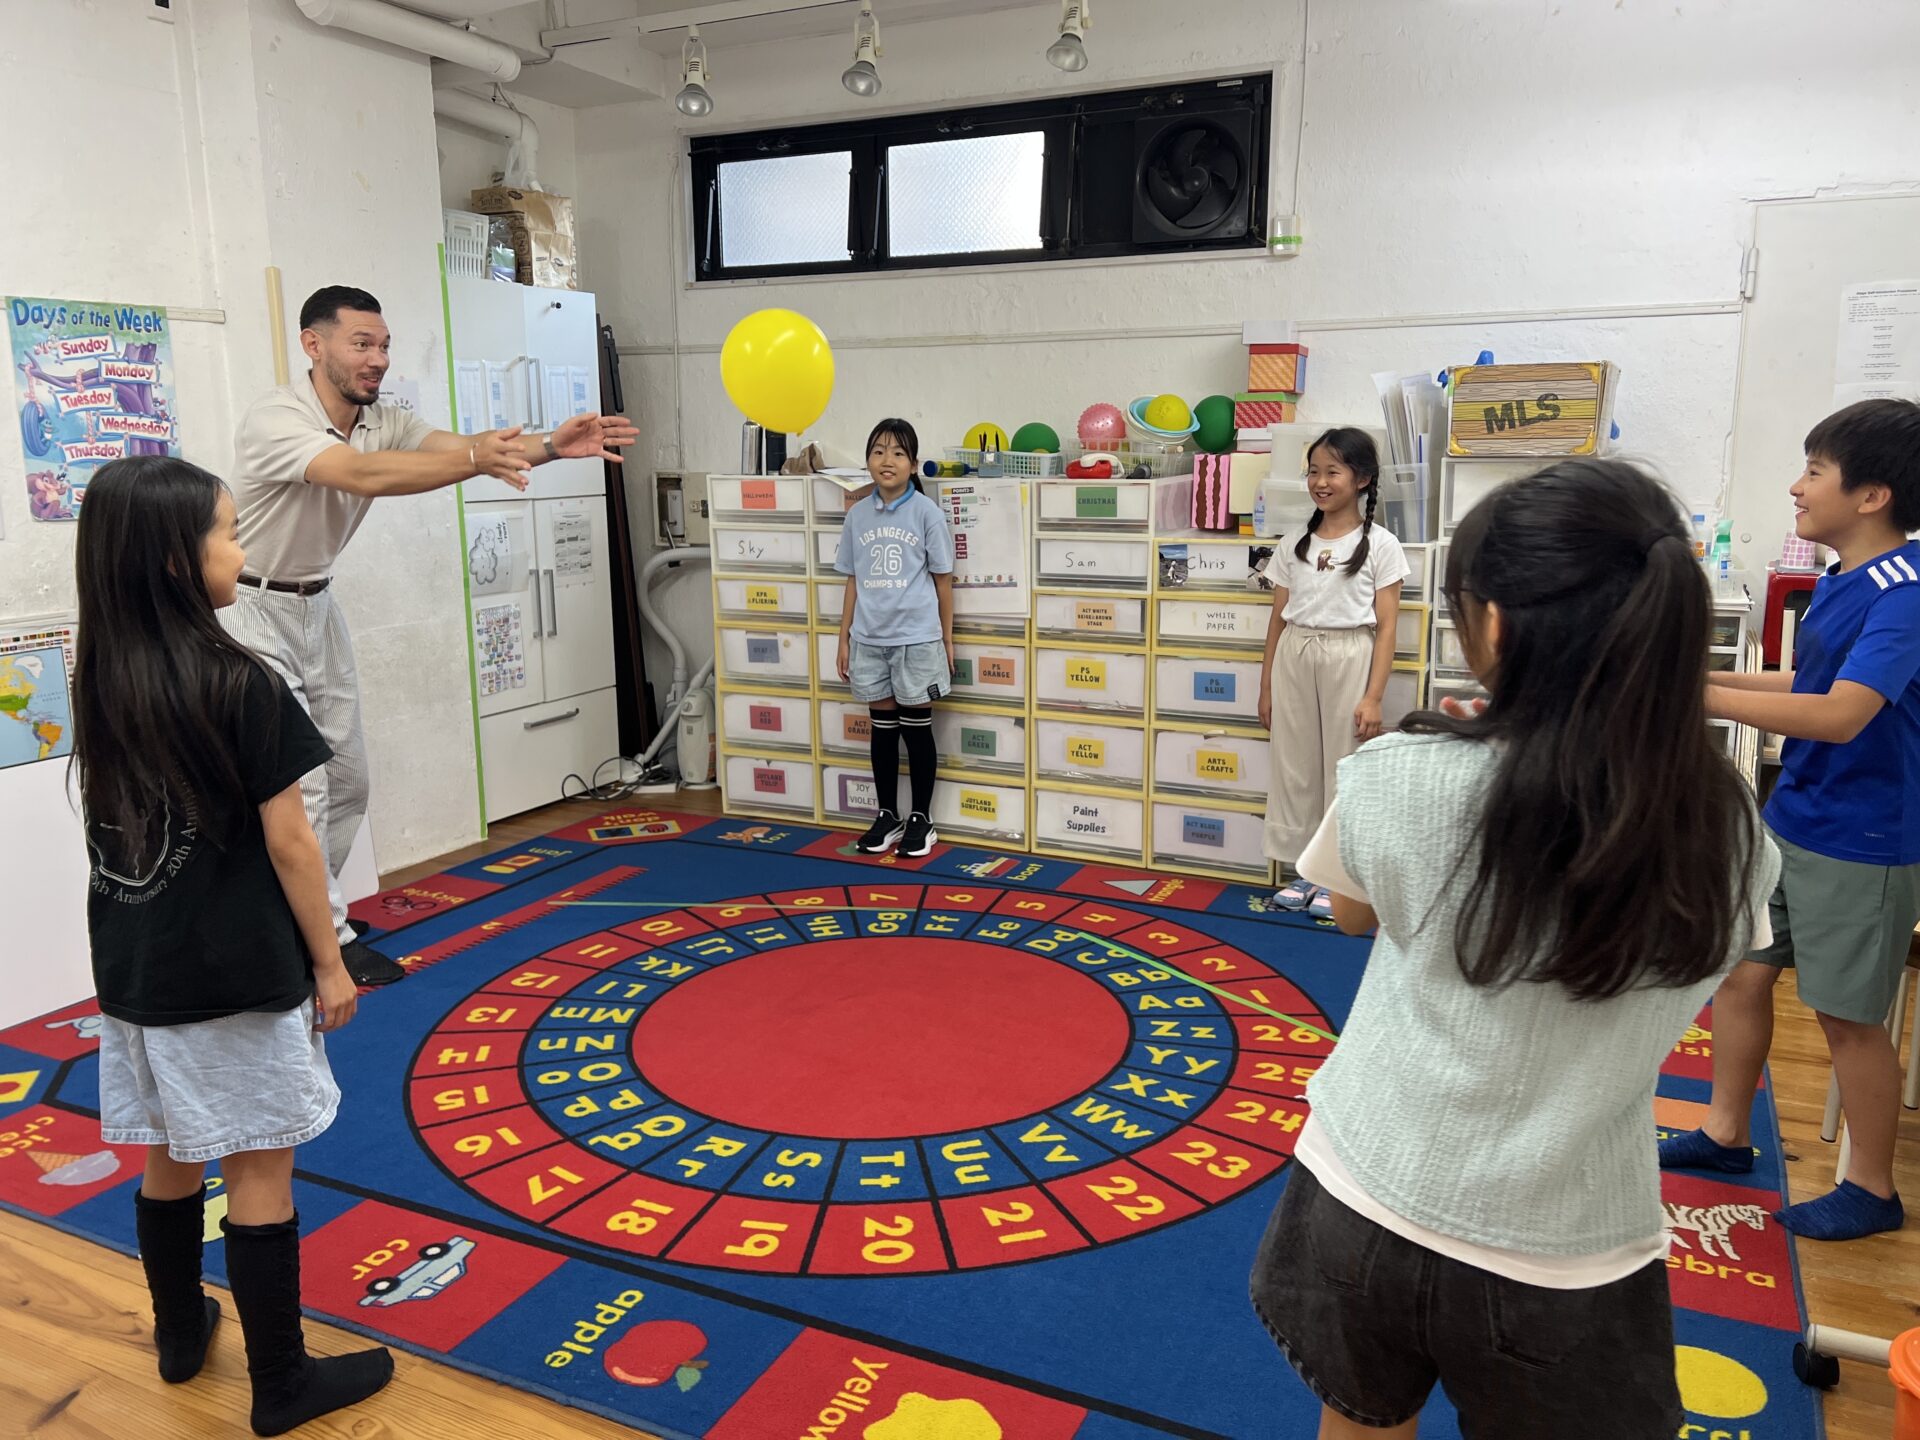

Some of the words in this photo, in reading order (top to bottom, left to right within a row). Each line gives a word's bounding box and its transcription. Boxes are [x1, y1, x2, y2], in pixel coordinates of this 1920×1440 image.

[12, 298, 67, 329] Days
[71, 310, 85, 325] of
[89, 309, 111, 327] the
[114, 307, 163, 333] Week
[61, 338, 109, 355] Sunday
[104, 363, 154, 380] Monday
[60, 390, 113, 408] Tuesday
[1483, 393, 1561, 434] MLS
[101, 417, 169, 435] Wednesday
[65, 444, 125, 460] Thursday
[1077, 497, 1115, 505] CHRISTMAS
[859, 530, 876, 546] LOS
[876, 526, 919, 546] ANGELES
[738, 539, 765, 559] Sky
[870, 544, 903, 576] 26
[1065, 551, 1097, 568] Sam
[1187, 552, 1226, 570] Chris
[863, 580, 893, 589] CHAMPS
[1206, 612, 1237, 620] WHITE
[1206, 622, 1235, 631] PAPER
[983, 670, 1011, 679] ORANGE
[1080, 666, 1090, 674] PS
[1070, 674, 1100, 683] YELLOW
[1209, 678, 1220, 686] PS
[1204, 685, 1225, 694] BLUE
[848, 727, 871, 735] ORANG
[967, 741, 990, 749] GREEN
[1078, 743, 1092, 751] ACT
[1070, 750, 1099, 760] YELLOW
[1207, 757, 1226, 765] ARTS
[1206, 765, 1234, 773] CRAFTS
[856, 784, 870, 792] JOY
[849, 796, 877, 806] VIOLET
[961, 802, 996, 813] SUNFLOWER
[966, 797, 992, 806] JOYLAND
[1073, 805, 1098, 817] Paint
[1066, 820, 1106, 834] Supplies
[758, 830, 791, 844] fox
[528, 846, 573, 858] jam
[165, 845, 192, 878] 20th
[1007, 863, 1044, 882] boat
[402, 886, 467, 905] bicycle
[869, 893, 899, 903] 7
[945, 893, 974, 903] 6
[1146, 878, 1185, 902] triangle
[793, 896, 825, 906] 8
[1015, 900, 1046, 911] 5
[1083, 913, 1116, 924] 4
[640, 919, 685, 937] 10
[1148, 932, 1180, 945] 3
[576, 944, 619, 958] 11
[1202, 957, 1237, 972] 2
[511, 971, 560, 989] 12
[1249, 989, 1271, 1004] 1
[465, 1007, 517, 1023] 13
[1251, 1023, 1322, 1044] 26
[437, 1045, 491, 1065] 14
[1250, 1062, 1316, 1087] 25
[433, 1085, 489, 1111] 15
[1225, 1101, 1304, 1133] 24
[0, 1116, 55, 1142] cre
[454, 1127, 522, 1157] 16
[1170, 1141, 1251, 1179] 23
[527, 1165, 585, 1205] 17
[1085, 1176, 1166, 1221] 22
[606, 1199, 674, 1235] 18
[980, 1202, 1048, 1244] 21
[723, 1220, 788, 1257] 19
[862, 1216, 915, 1264] 20
[352, 1239, 410, 1280] car
[1665, 1254, 1777, 1288] ebra
[544, 1289, 645, 1368] apple
